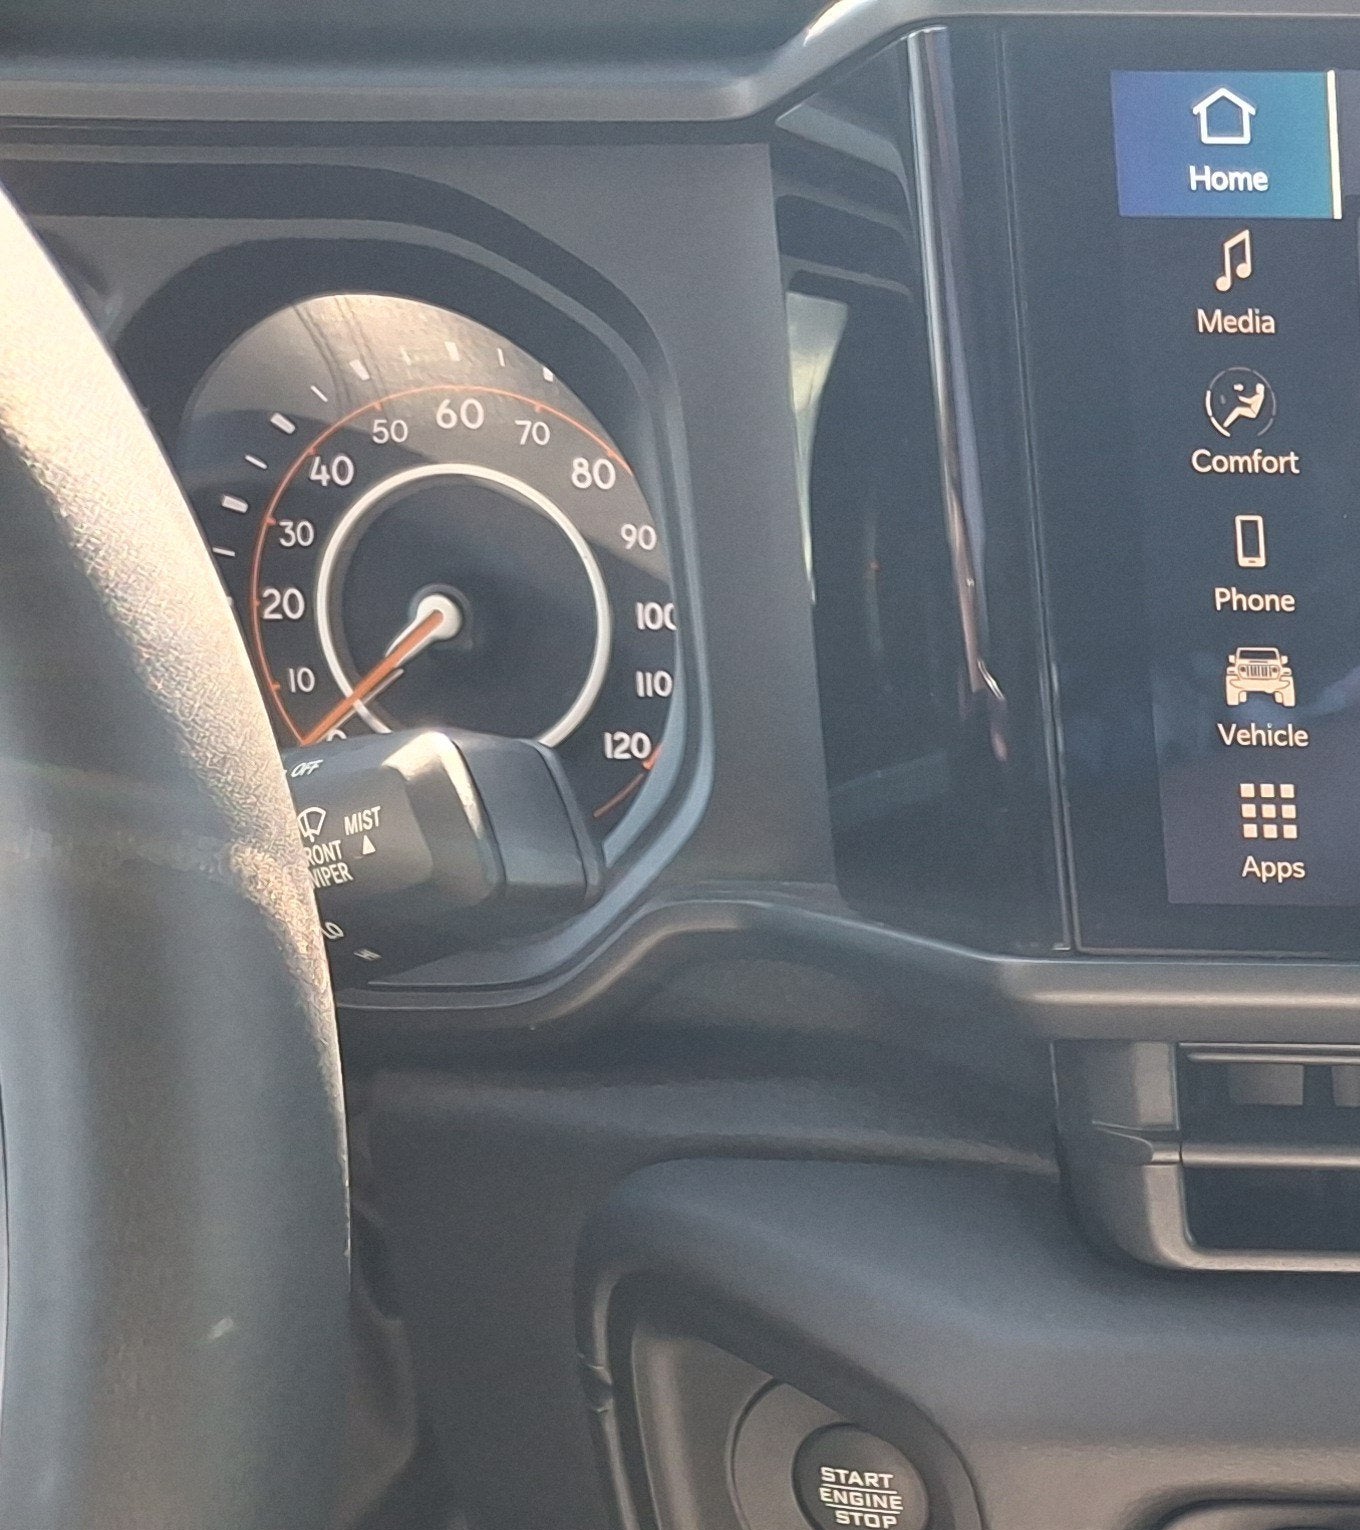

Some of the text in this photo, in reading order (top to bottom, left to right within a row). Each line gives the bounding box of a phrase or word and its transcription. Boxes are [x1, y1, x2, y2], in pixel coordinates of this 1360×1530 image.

[1189, 165, 1269, 193] Home
[1196, 309, 1276, 335] Media
[436, 398, 484, 430] 60
[372, 419, 408, 444] 50
[515, 420, 550, 446] 70
[309, 455, 354, 487] 40
[571, 458, 616, 490] 80
[1191, 449, 1300, 476] Comfort
[278, 521, 314, 548] 30
[621, 524, 657, 551] 90
[262, 588, 304, 620] 20
[1214, 587, 1296, 614] Phone
[288, 668, 315, 694] 10
[635, 669, 673, 698] 110
[604, 731, 651, 761] 120
[1217, 722, 1309, 749] Vehicle
[290, 759, 324, 778] OFF
[344, 805, 381, 836] MIST
[303, 839, 343, 866] RONT
[1242, 856, 1306, 883] Apps
[820, 1466, 894, 1489] START
[818, 1487, 903, 1510] ENGINE
[834, 1510, 898, 1529] STOP
